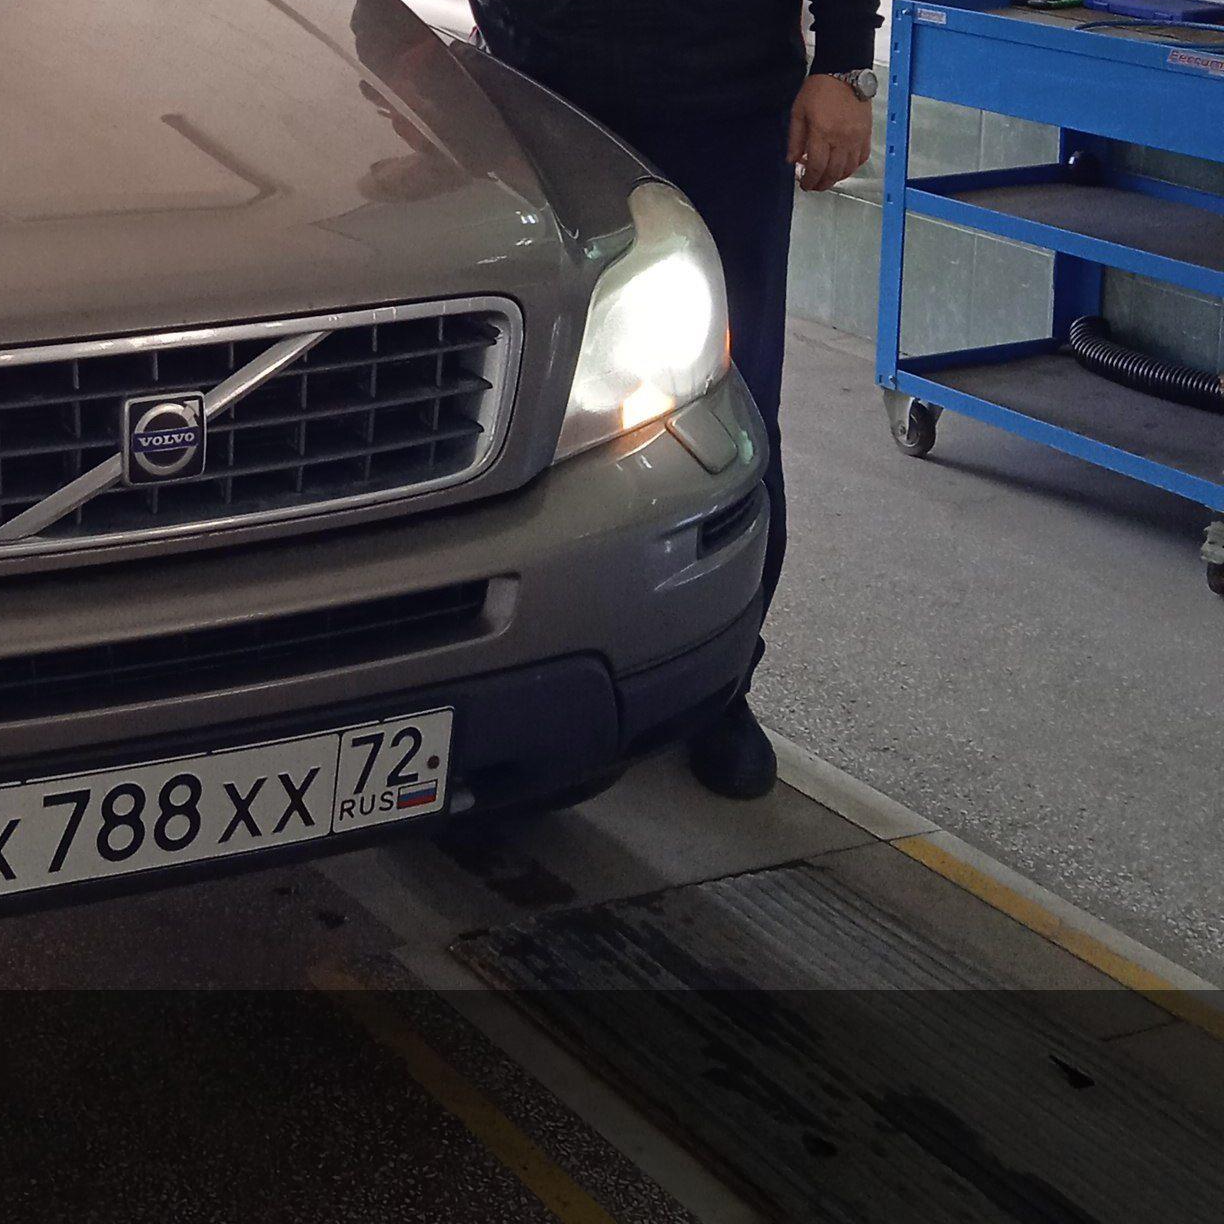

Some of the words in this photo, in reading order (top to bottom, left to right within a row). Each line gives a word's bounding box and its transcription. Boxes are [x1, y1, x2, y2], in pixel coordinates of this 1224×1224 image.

[138, 432, 195, 447] VOLVO
[351, 726, 423, 795] 72
[339, 791, 394, 821] RUS
